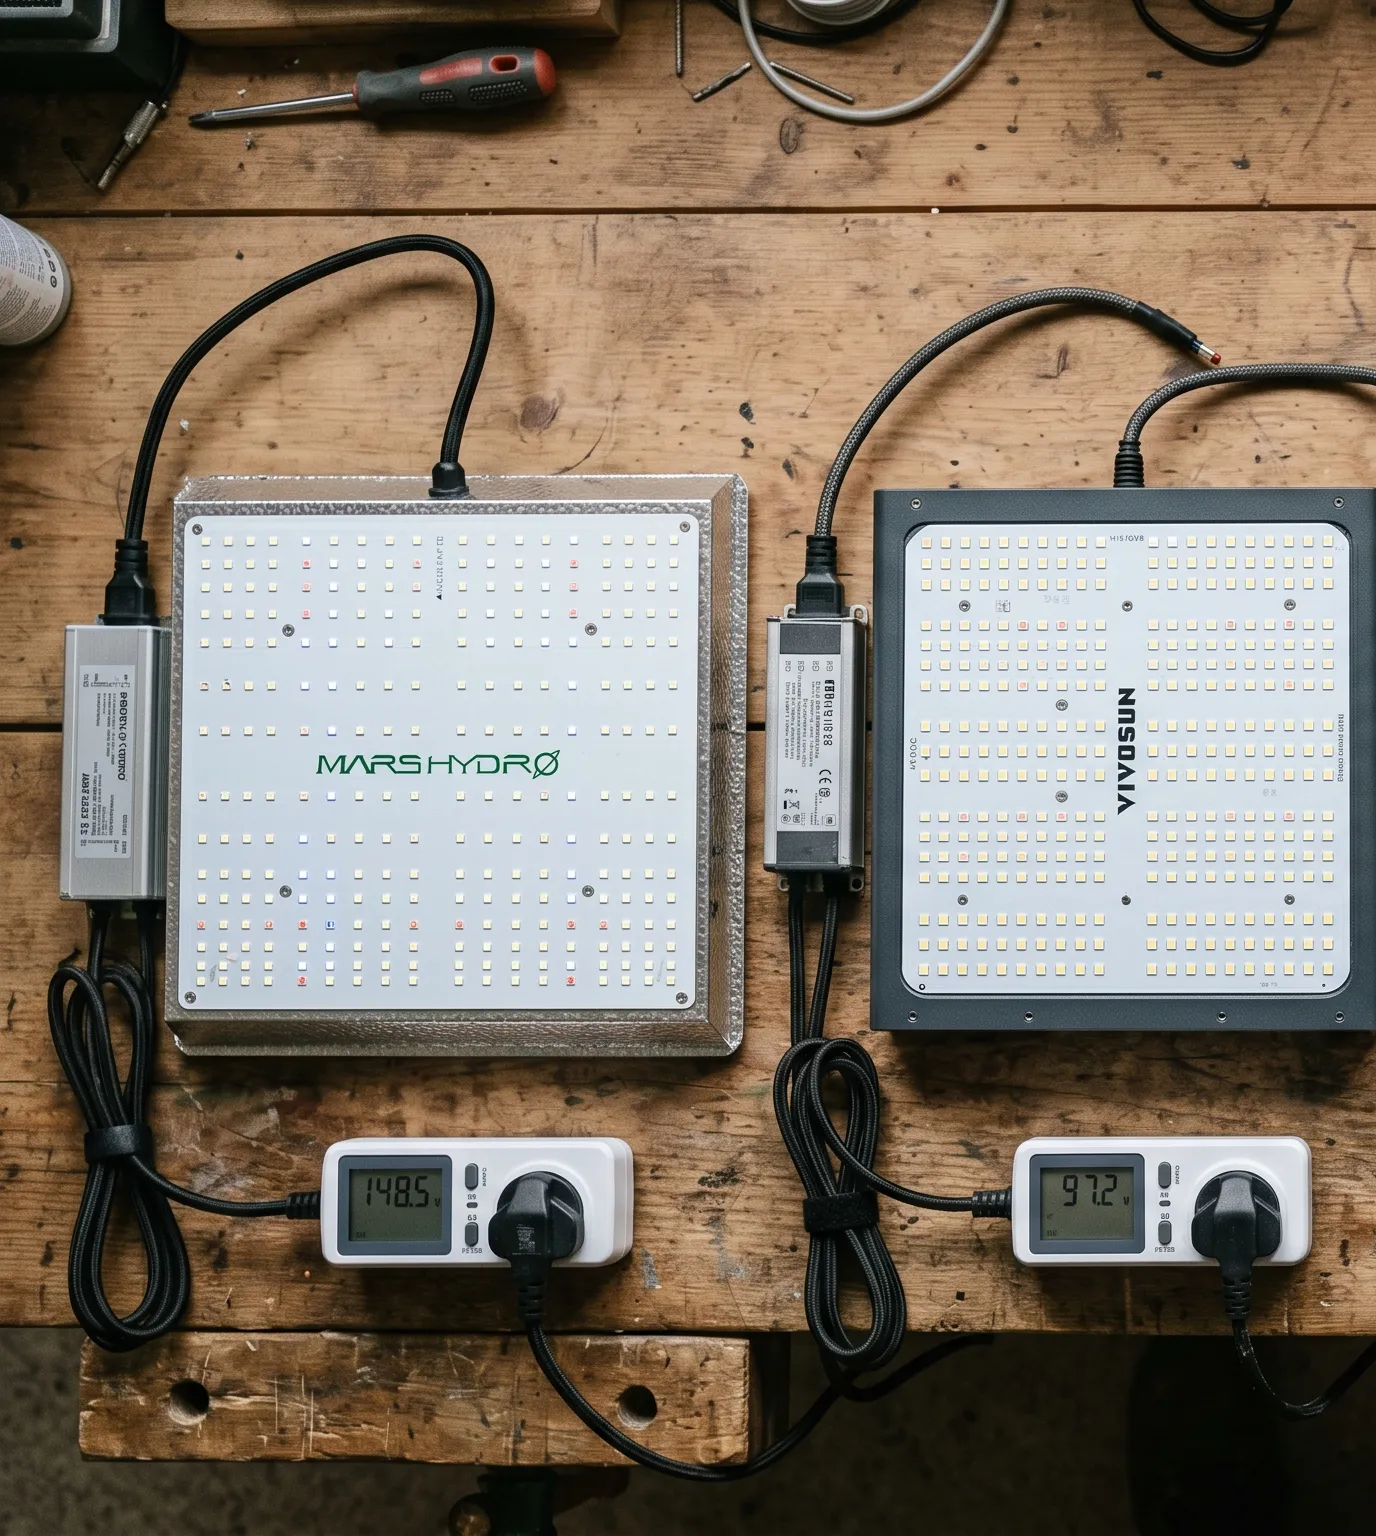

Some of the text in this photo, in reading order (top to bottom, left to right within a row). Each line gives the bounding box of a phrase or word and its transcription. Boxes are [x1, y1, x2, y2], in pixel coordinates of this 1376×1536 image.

[1117, 688, 1136, 815] VIVOSUN
[366, 1175, 430, 1208] 148.5
[1063, 1174, 1119, 1206] 97.2
